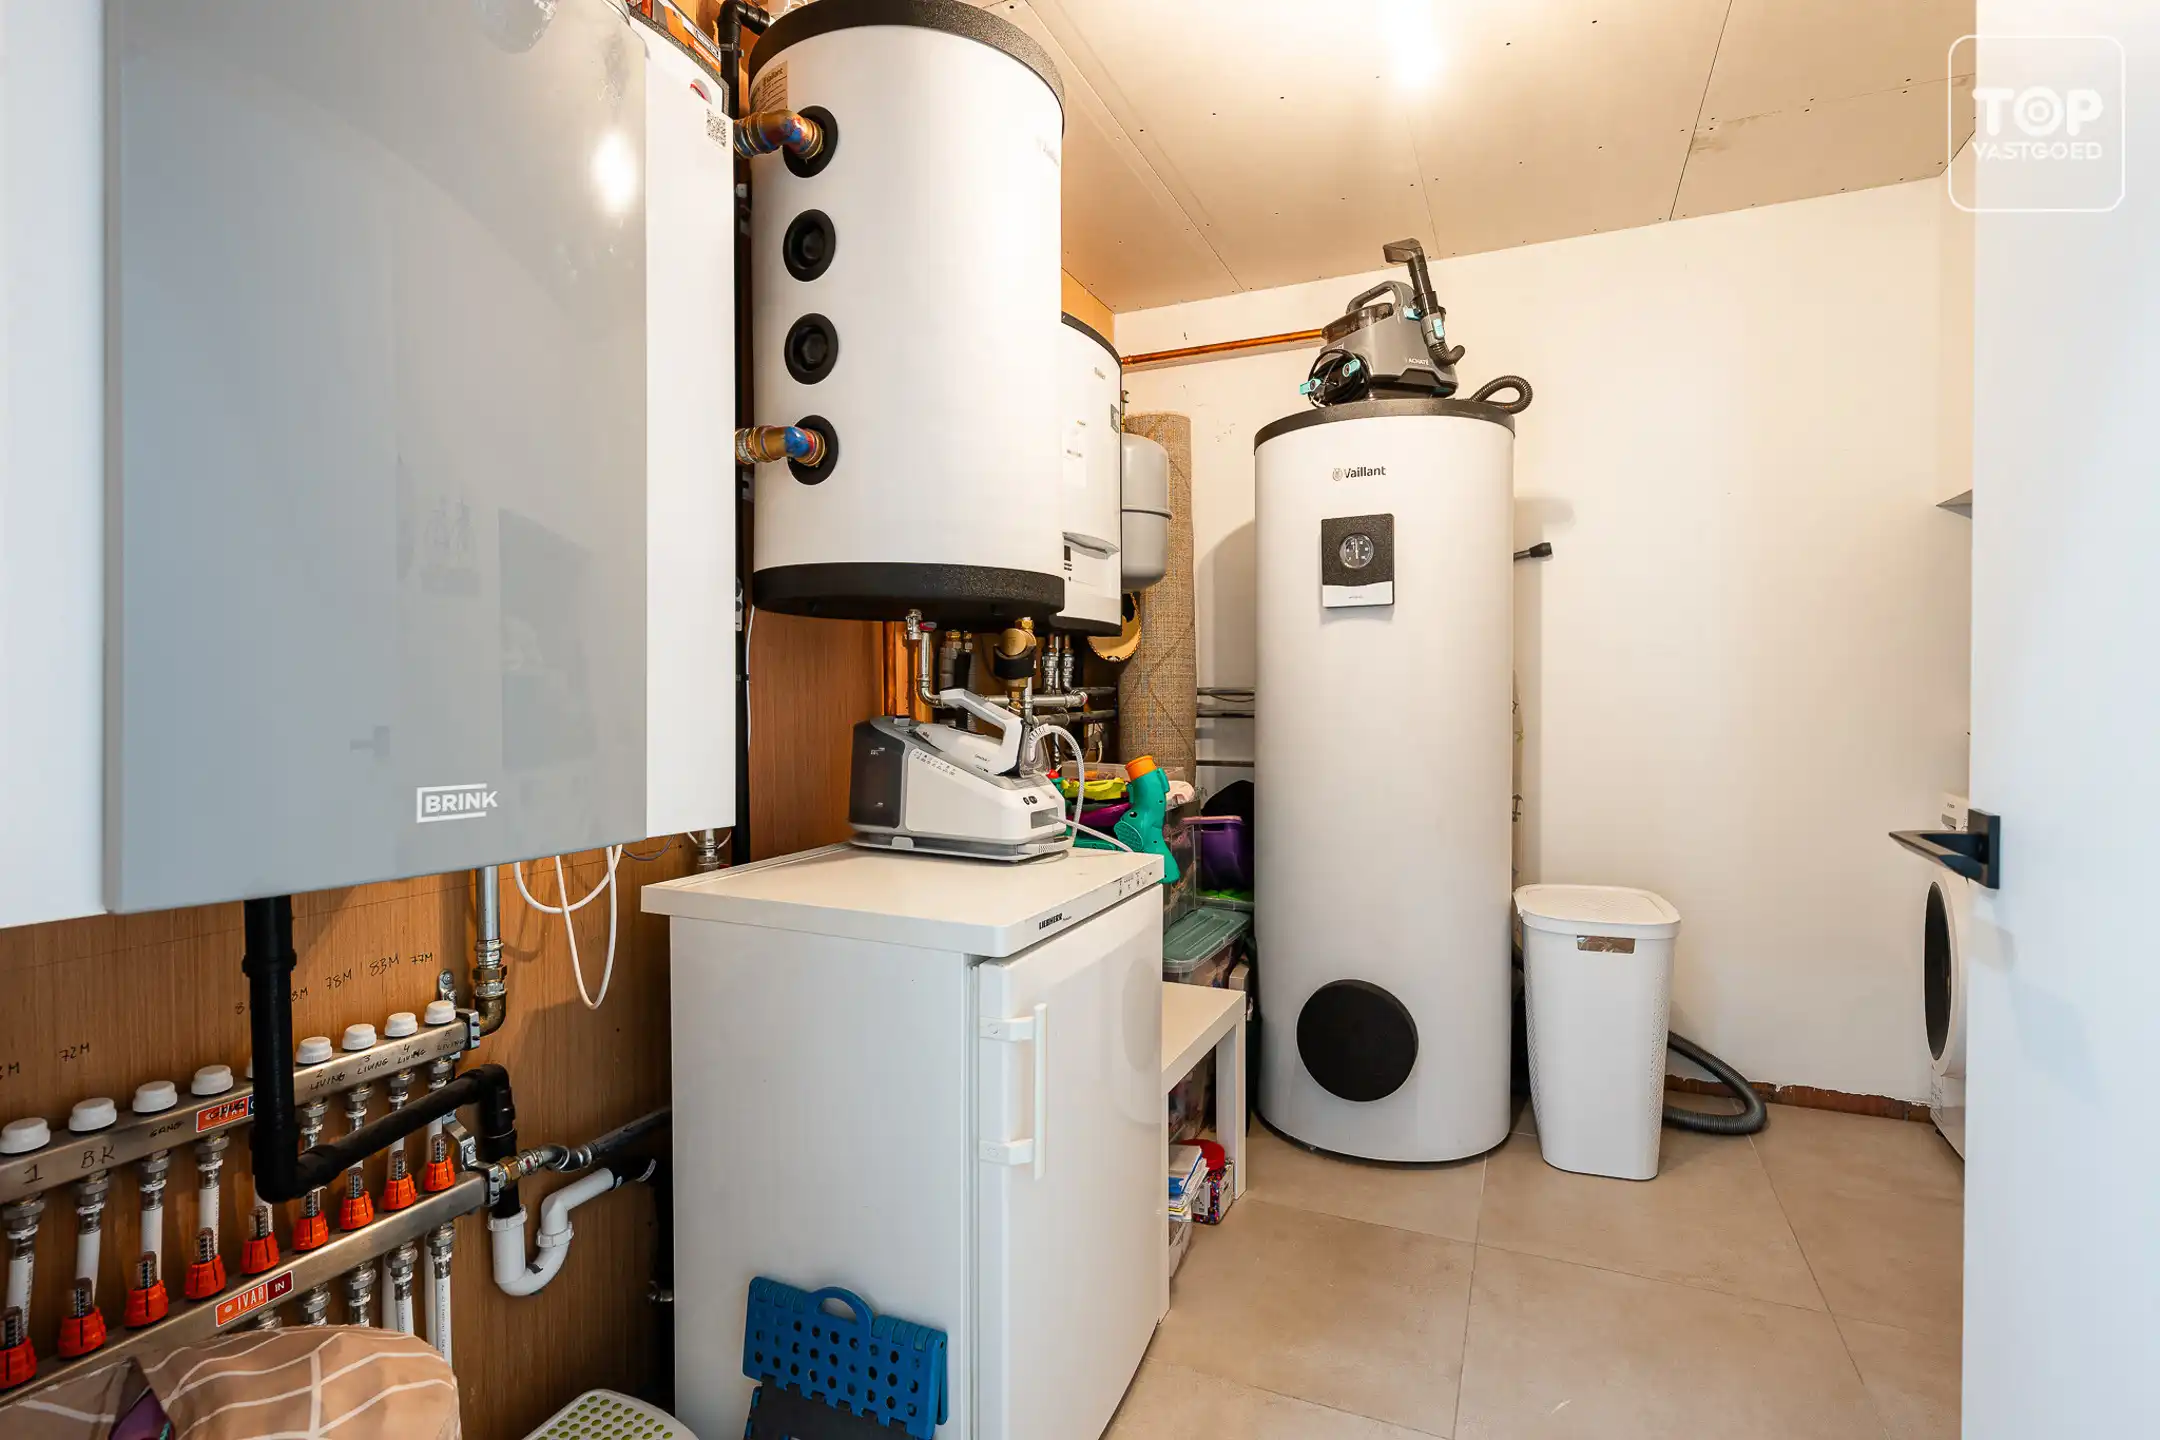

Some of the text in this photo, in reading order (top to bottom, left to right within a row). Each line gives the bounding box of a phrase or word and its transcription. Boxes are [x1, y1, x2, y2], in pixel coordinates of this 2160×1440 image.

[1344, 466, 1387, 479] Vaillant
[425, 791, 498, 813] BRINK
[369, 953, 400, 977] 83M
[325, 968, 352, 990] 78M
[403, 1044, 411, 1053] 4
[357, 1057, 389, 1075] LIVING
[237, 1280, 285, 1311] IVAR IN
